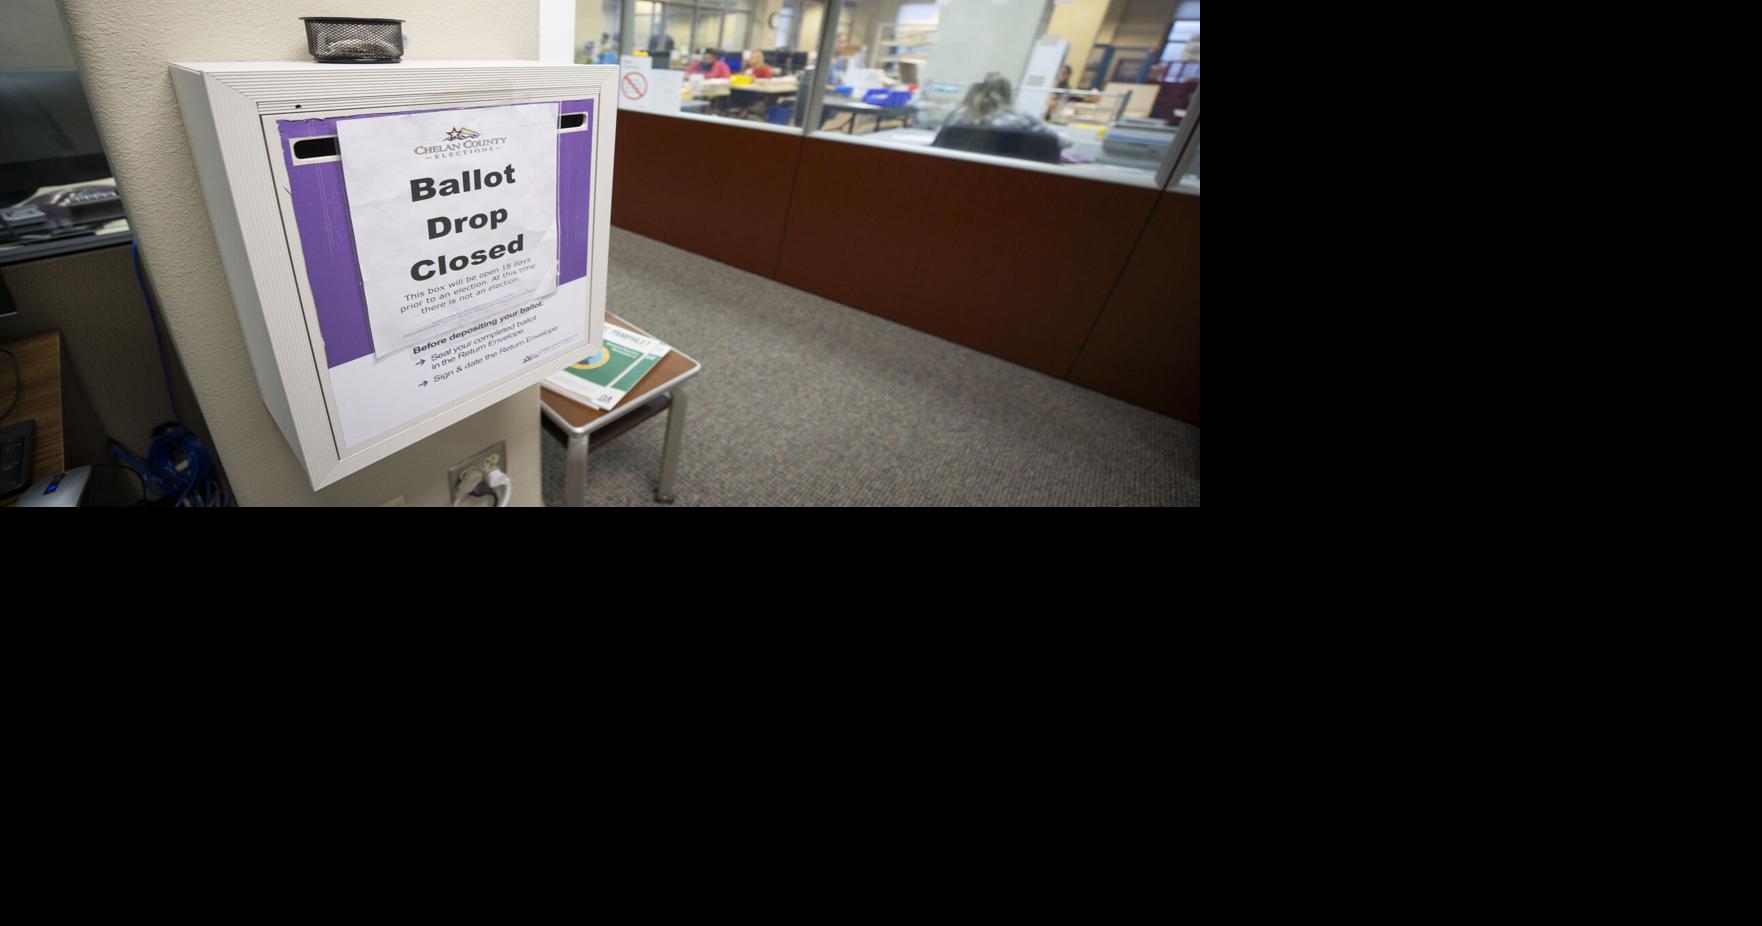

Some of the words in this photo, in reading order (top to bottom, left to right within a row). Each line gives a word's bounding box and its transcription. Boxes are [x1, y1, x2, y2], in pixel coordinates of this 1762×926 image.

[414, 142, 461, 155] CHELAN
[463, 136, 507, 149] COUNTY
[410, 163, 516, 202] Ballot
[427, 208, 508, 240] Drop
[404, 290, 425, 302] This
[427, 285, 445, 294] box
[448, 278, 463, 289] will
[465, 274, 477, 282] be
[479, 268, 499, 279] open
[513, 257, 532, 267] days
[410, 233, 524, 281] Closed
[400, 300, 423, 314] prior
[426, 295, 436, 304] to
[439, 291, 451, 300] an
[453, 280, 489, 296] election.
[502, 269, 517, 280] this
[519, 263, 536, 273] time
[421, 301, 446, 314] there
[448, 297, 457, 305] is
[459, 291, 473, 302] not
[475, 287, 487, 297] an
[488, 279, 521, 292] election.
[413, 337, 447, 355] Before
[449, 318, 498, 343] depositing
[499, 310, 519, 324] your
[431, 349, 452, 361] Seal
[453, 341, 472, 353] your
[473, 324, 516, 345] completed
[516, 315, 537, 328] ballot
[433, 370, 455, 383] Sign
[464, 357, 484, 368] date
[485, 351, 498, 360] the
[499, 340, 525, 354] Return
[526, 326, 559, 343] Envelope
[441, 356, 456, 367] the
[458, 345, 487, 359] Return
[488, 328, 524, 346] Envelope
